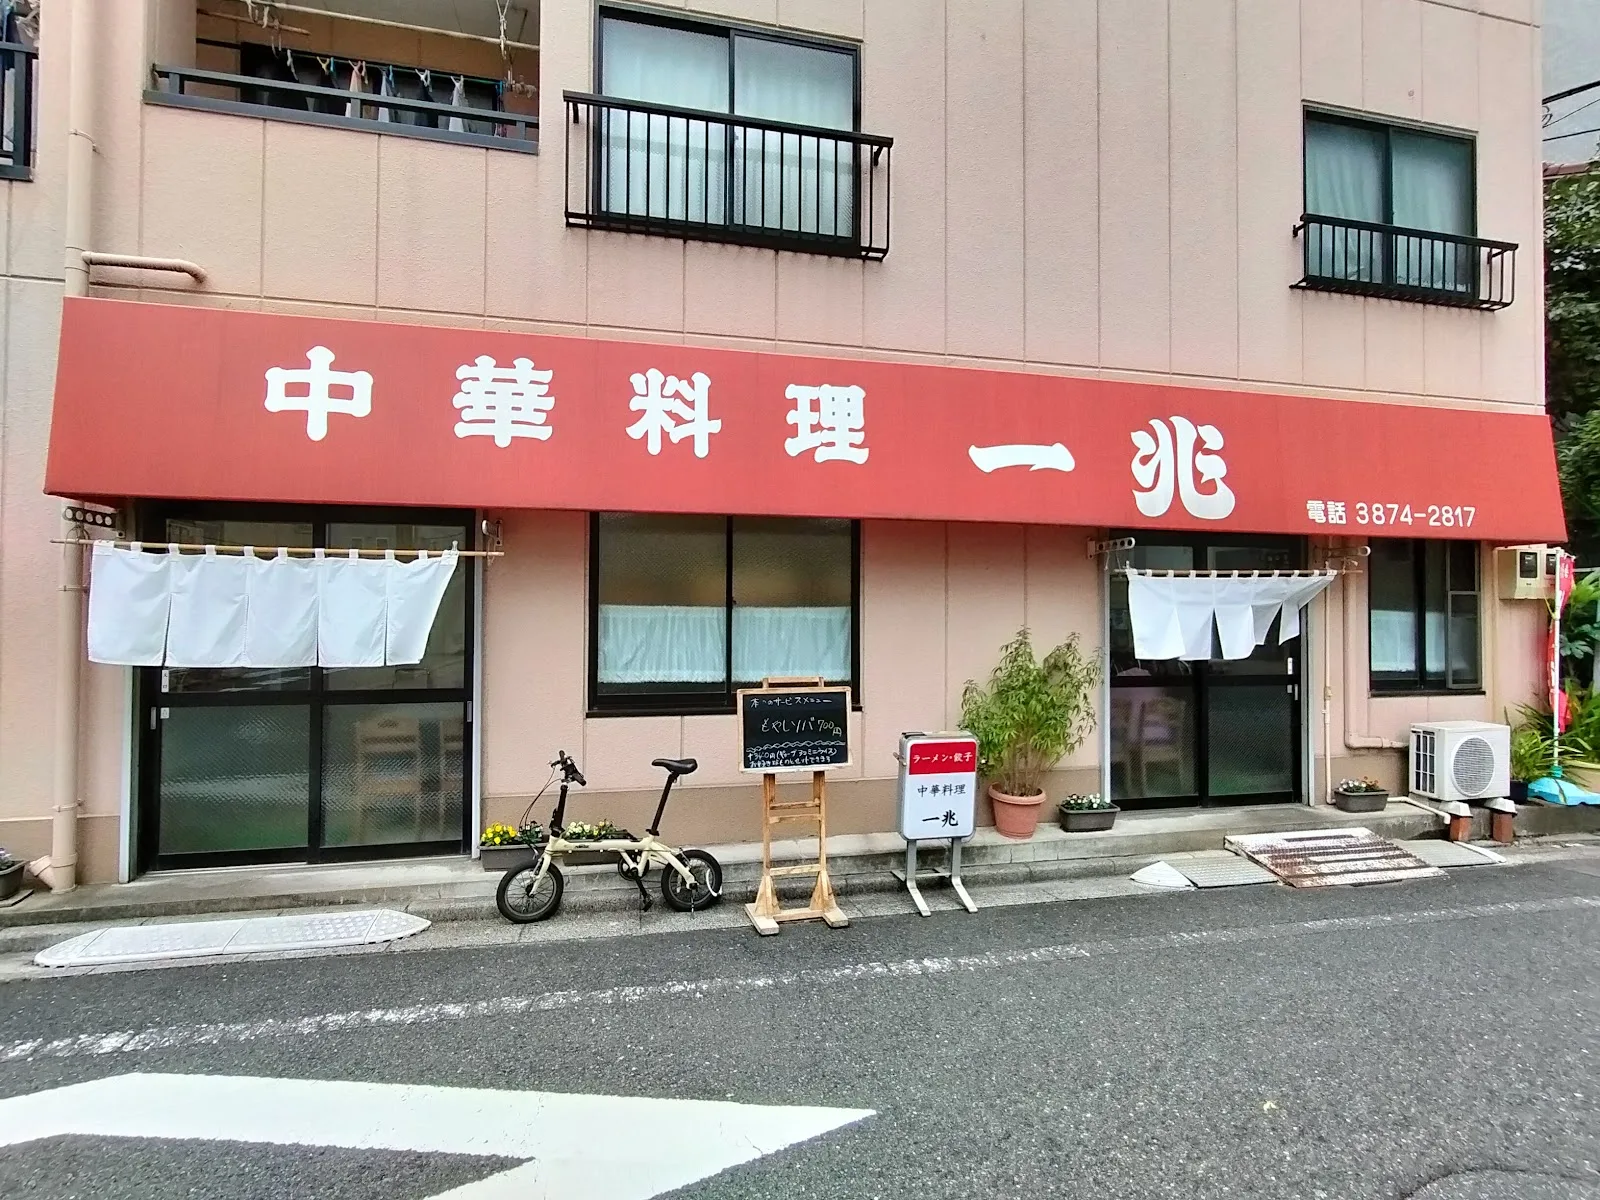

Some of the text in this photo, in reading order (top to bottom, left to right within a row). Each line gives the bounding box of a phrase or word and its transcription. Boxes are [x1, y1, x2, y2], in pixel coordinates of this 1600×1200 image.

[264, 346, 1236, 520] 中華料理 一兆
[1306, 500, 1476, 528] 電話 3874-2817
[912, 751, 974, 764] ラーメン・餃子
[917, 784, 967, 798] 中華料理
[922, 809, 959, 828] 一兆
